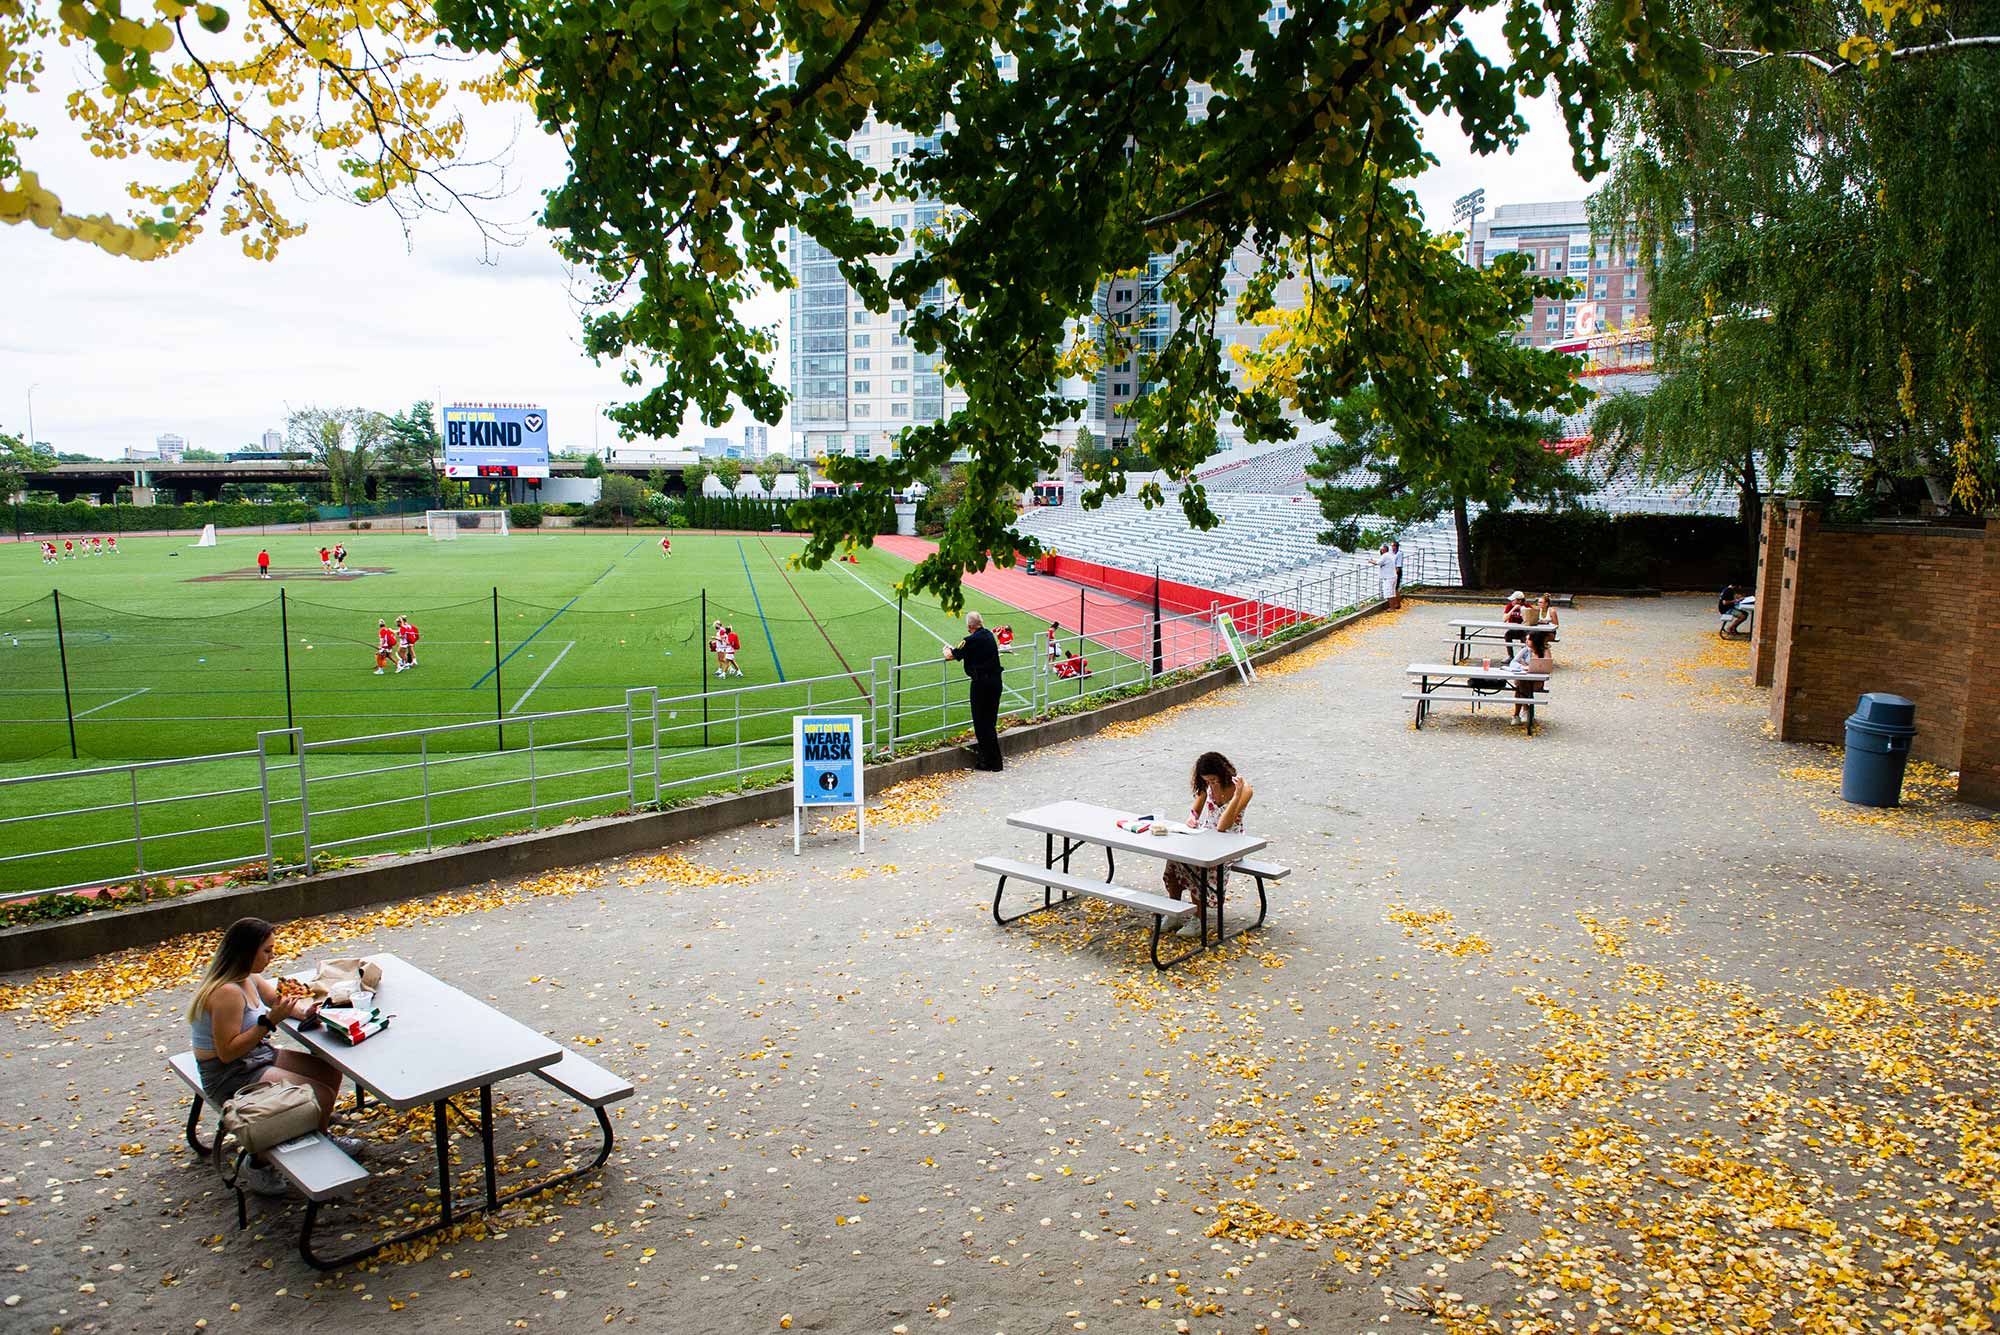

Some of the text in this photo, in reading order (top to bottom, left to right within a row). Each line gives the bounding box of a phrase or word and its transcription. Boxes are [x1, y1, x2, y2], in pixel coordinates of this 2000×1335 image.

[1576, 303, 1594, 334] G
[448, 421, 522, 447] BE KIND
[805, 731, 851, 744] WEAR A
[804, 744, 852, 760] MASK
